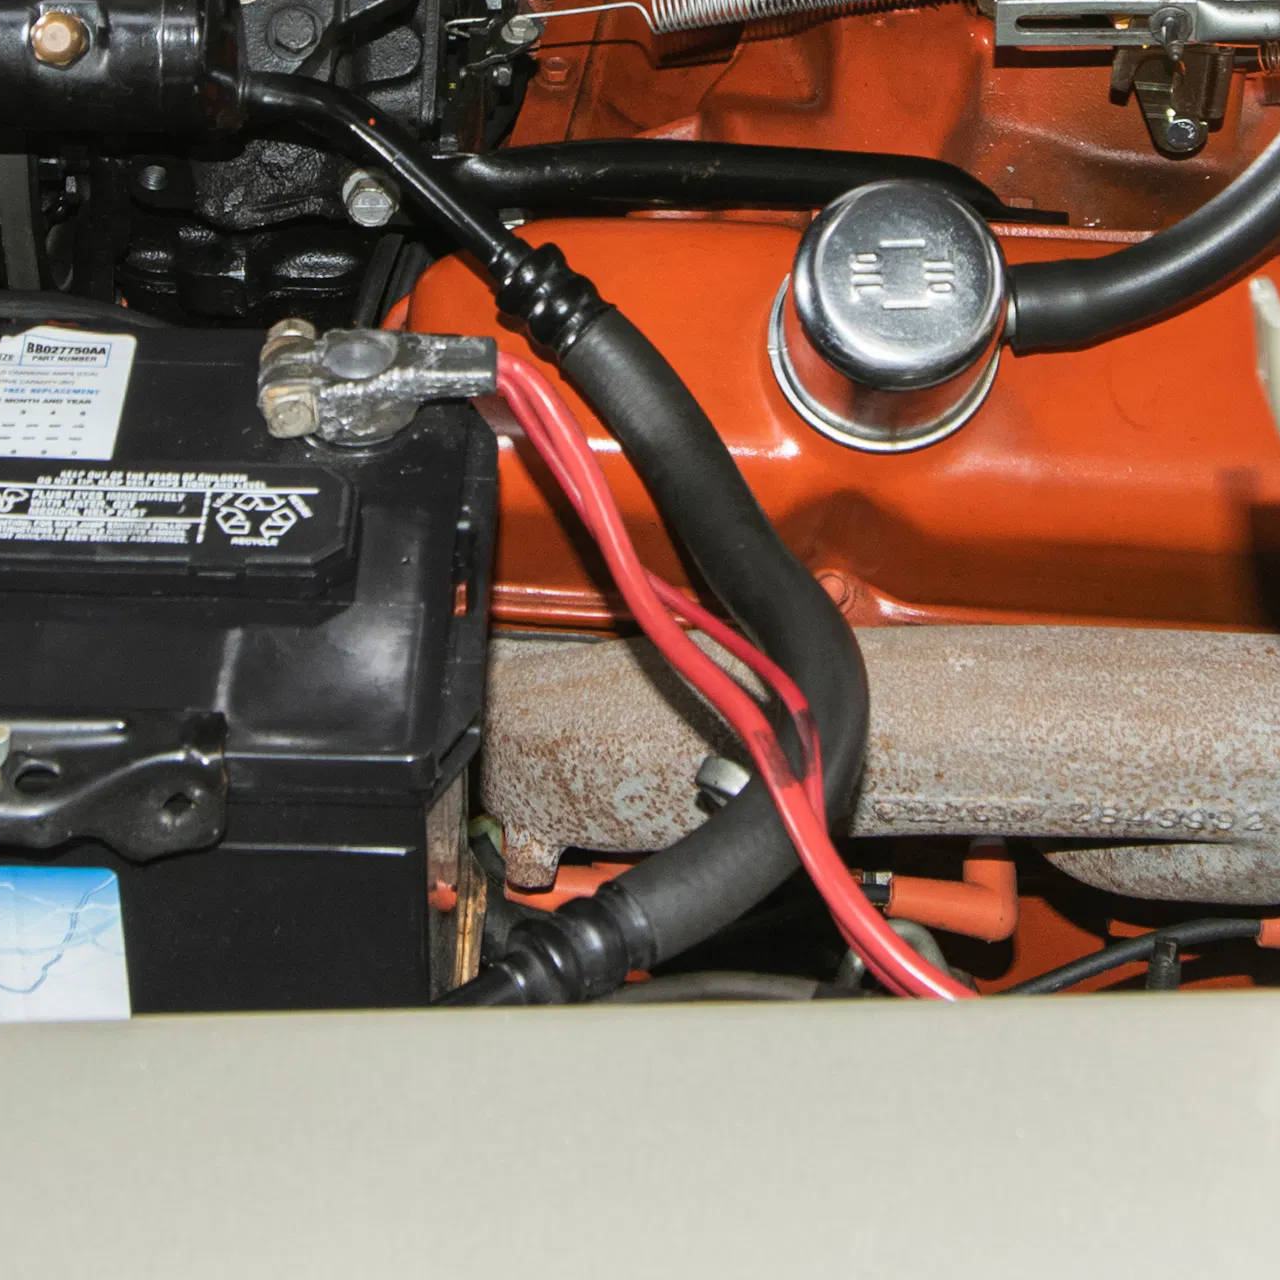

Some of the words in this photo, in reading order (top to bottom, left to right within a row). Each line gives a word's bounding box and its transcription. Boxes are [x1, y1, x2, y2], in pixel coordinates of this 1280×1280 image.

[26, 342, 107, 355] BB027750AA
[31, 490, 72, 500] FLUSH
[73, 491, 104, 500] EYES
[106, 492, 186, 502] IMMEDIATELY
[30, 499, 62, 508] WITH
[27, 507, 81, 517] MEDICAL
[82, 508, 115, 517] HELP
[116, 509, 148, 518] FAST
[230, 536, 279, 547] RECYCLE
